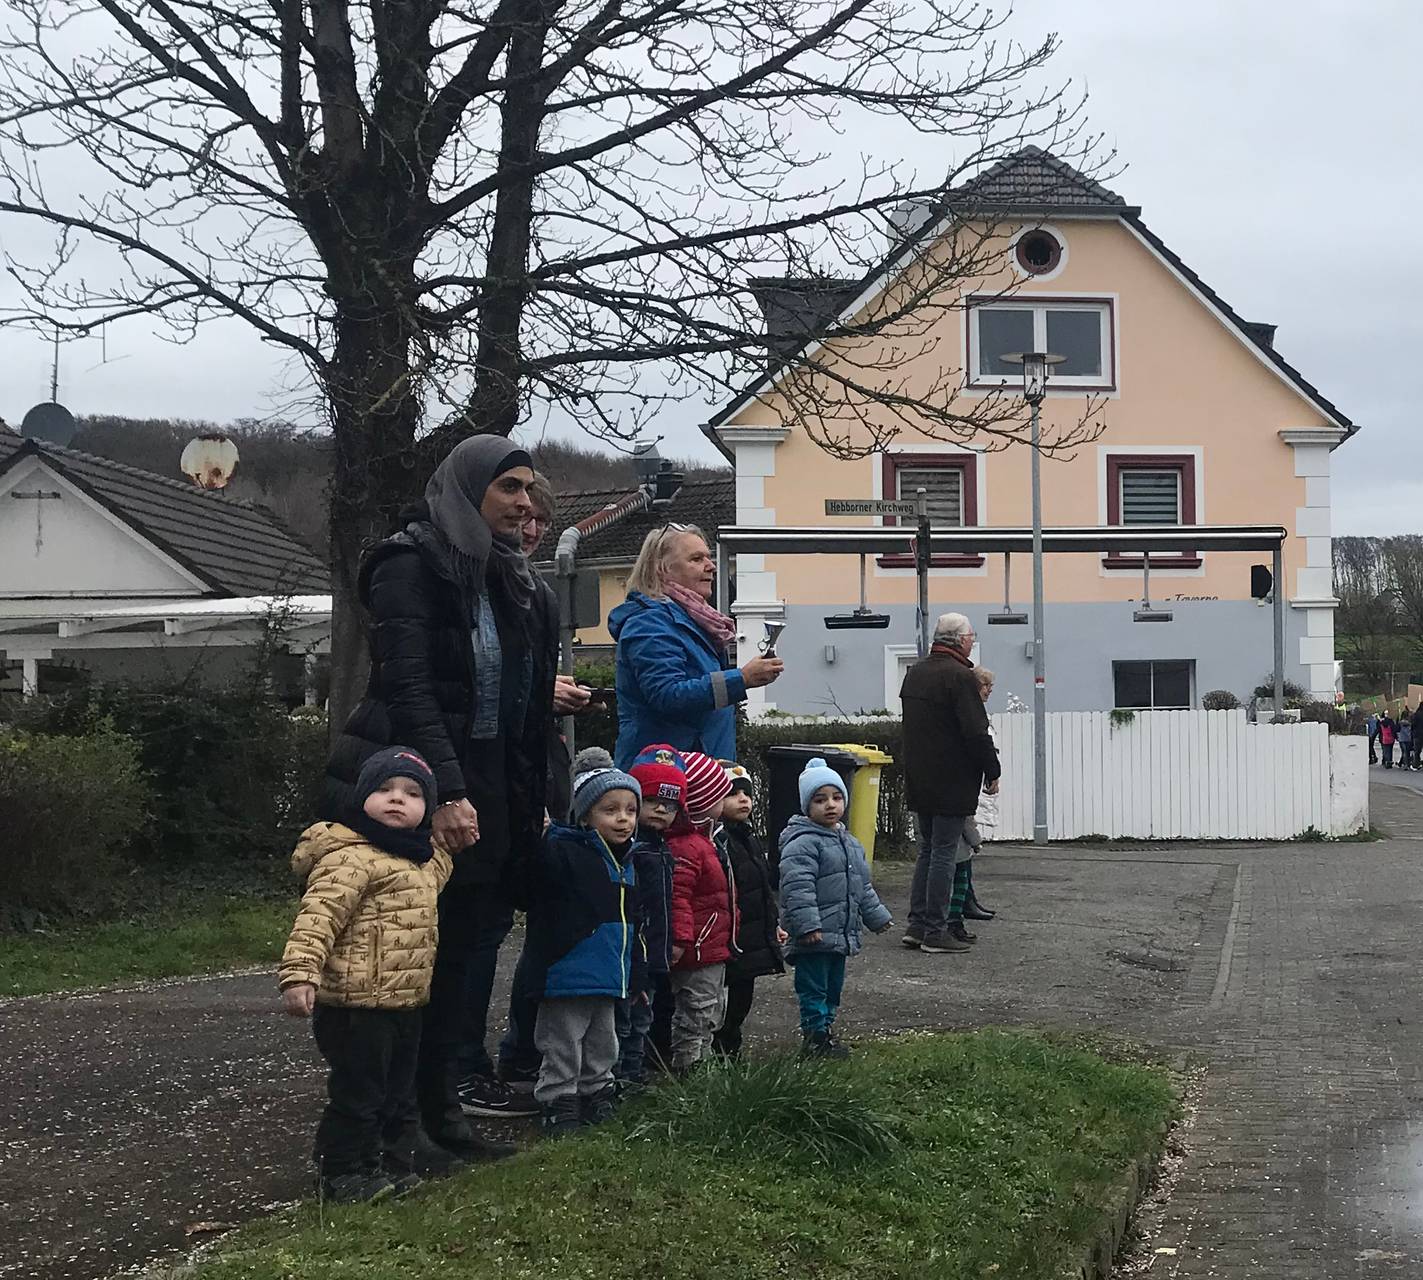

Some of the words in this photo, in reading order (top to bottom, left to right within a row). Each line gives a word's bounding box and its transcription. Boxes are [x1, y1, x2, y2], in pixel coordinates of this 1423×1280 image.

[830, 501, 873, 513] Hebborner
[876, 502, 914, 515] Kirchweg
[658, 788, 680, 800] SAM
